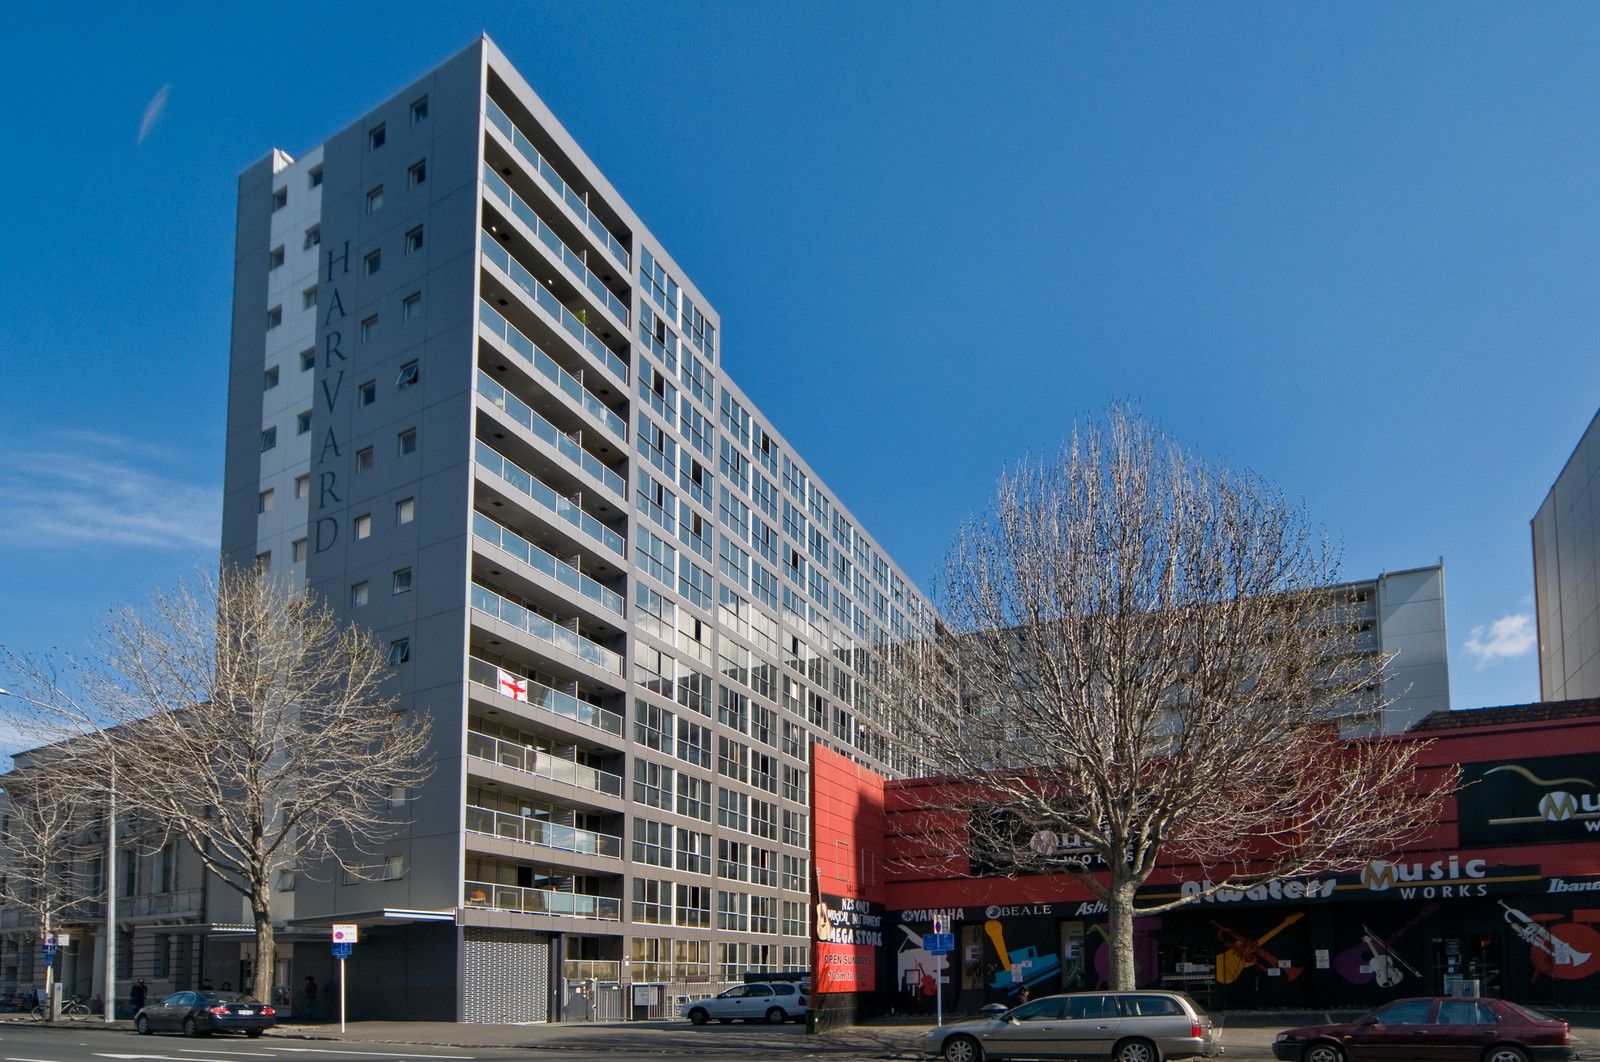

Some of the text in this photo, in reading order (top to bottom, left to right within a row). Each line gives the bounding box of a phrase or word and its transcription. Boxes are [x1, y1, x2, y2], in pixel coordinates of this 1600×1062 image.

[313, 238, 350, 555] HARVARD
[1180, 855, 1487, 904] Atwaters Music
[1400, 884, 1488, 900] WORKS
[913, 908, 965, 922] YAMAHA
[1002, 905, 1052, 917] BEALE
[828, 928, 882, 947] MEGA STORE
[824, 954, 842, 965] OPEN
